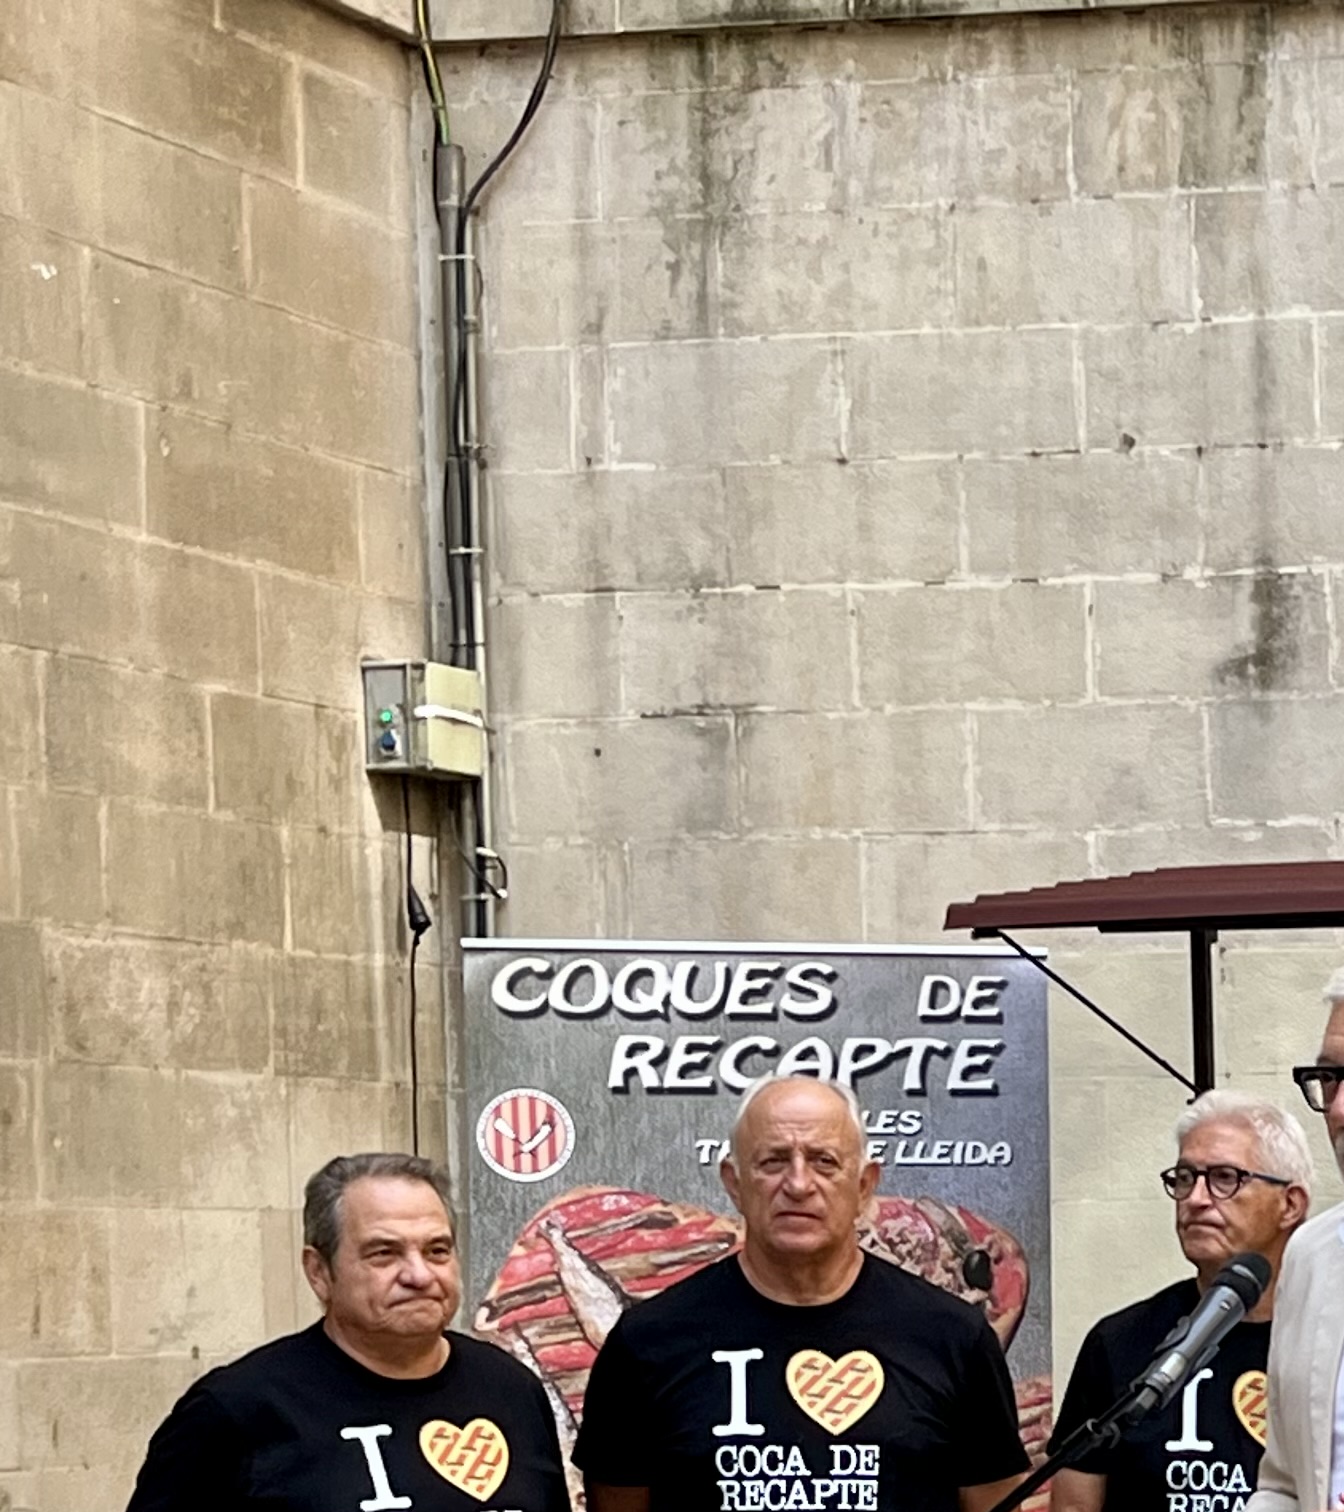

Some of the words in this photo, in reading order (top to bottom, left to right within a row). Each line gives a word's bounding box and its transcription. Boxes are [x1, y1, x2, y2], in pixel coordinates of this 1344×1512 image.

[491, 958, 838, 1015] COQUES
[917, 975, 1006, 1017] DE
[607, 1035, 1004, 1090] RECAPTE
[895, 1140, 1012, 1165] LLEIDA
[712, 1348, 765, 1437] I
[341, 1424, 412, 1512] I
[715, 1445, 811, 1477] COCA
[829, 1444, 880, 1476] DE
[1166, 1460, 1251, 1492] COCA
[716, 1479, 879, 1511] RECAPTE
